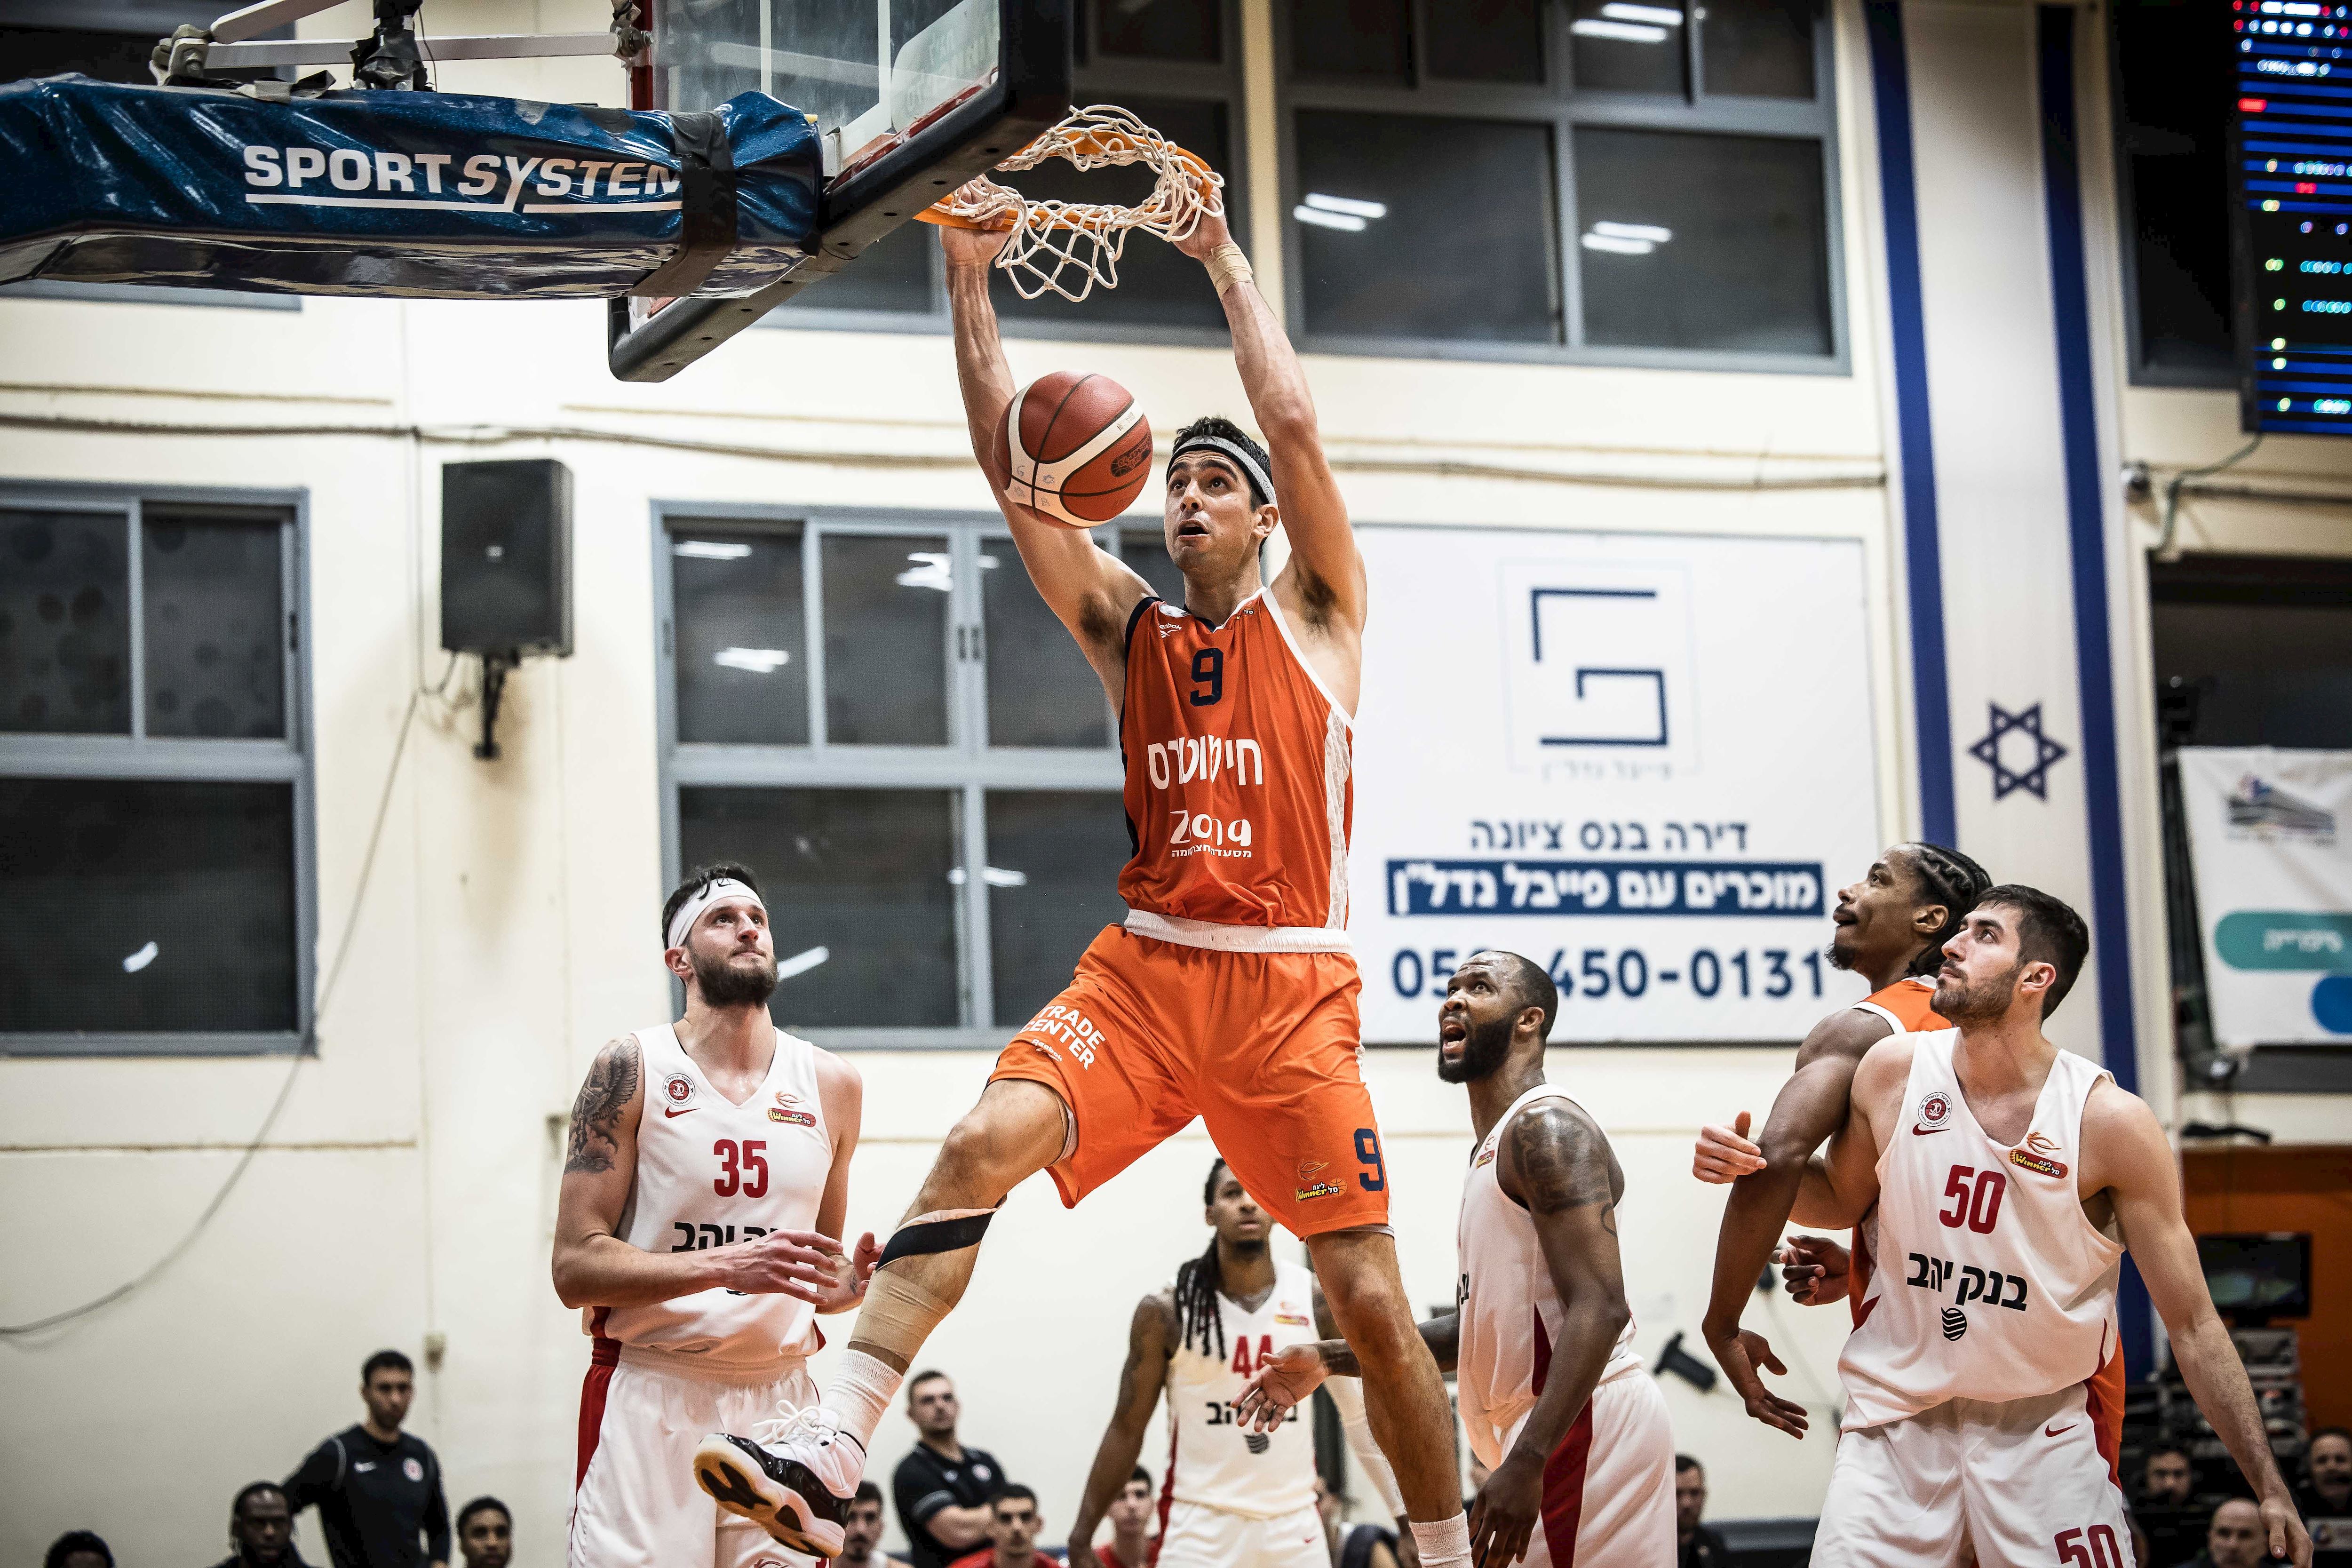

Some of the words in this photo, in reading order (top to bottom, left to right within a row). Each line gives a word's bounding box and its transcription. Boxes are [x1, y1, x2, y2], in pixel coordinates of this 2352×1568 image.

[243, 145, 451, 193] SPORT
[1190, 647, 1224, 706] 9
[1470, 820, 1564, 850] ציונה
[1579, 820, 1649, 851] בנס
[1664, 821, 1748, 852] דירה
[1502, 861, 1611, 908] פייבל
[1617, 869, 1677, 909] עם
[1684, 869, 1819, 909] מוכרים
[1019, 1019, 1095, 1071] CENTER
[1038, 1005, 1106, 1051] TRADE
[772, 1112, 803, 1123] Winner
[713, 1139, 769, 1198] 35
[1353, 1128, 1385, 1192] 9
[2015, 1153, 2051, 1172] Winner
[2051, 1167, 2060, 1176] סל
[1298, 1188, 1327, 1200] Winner
[1939, 1164, 2007, 1234] 50
[1907, 1252, 1954, 1293] יהב
[1955, 1265, 2028, 1312] בנק
